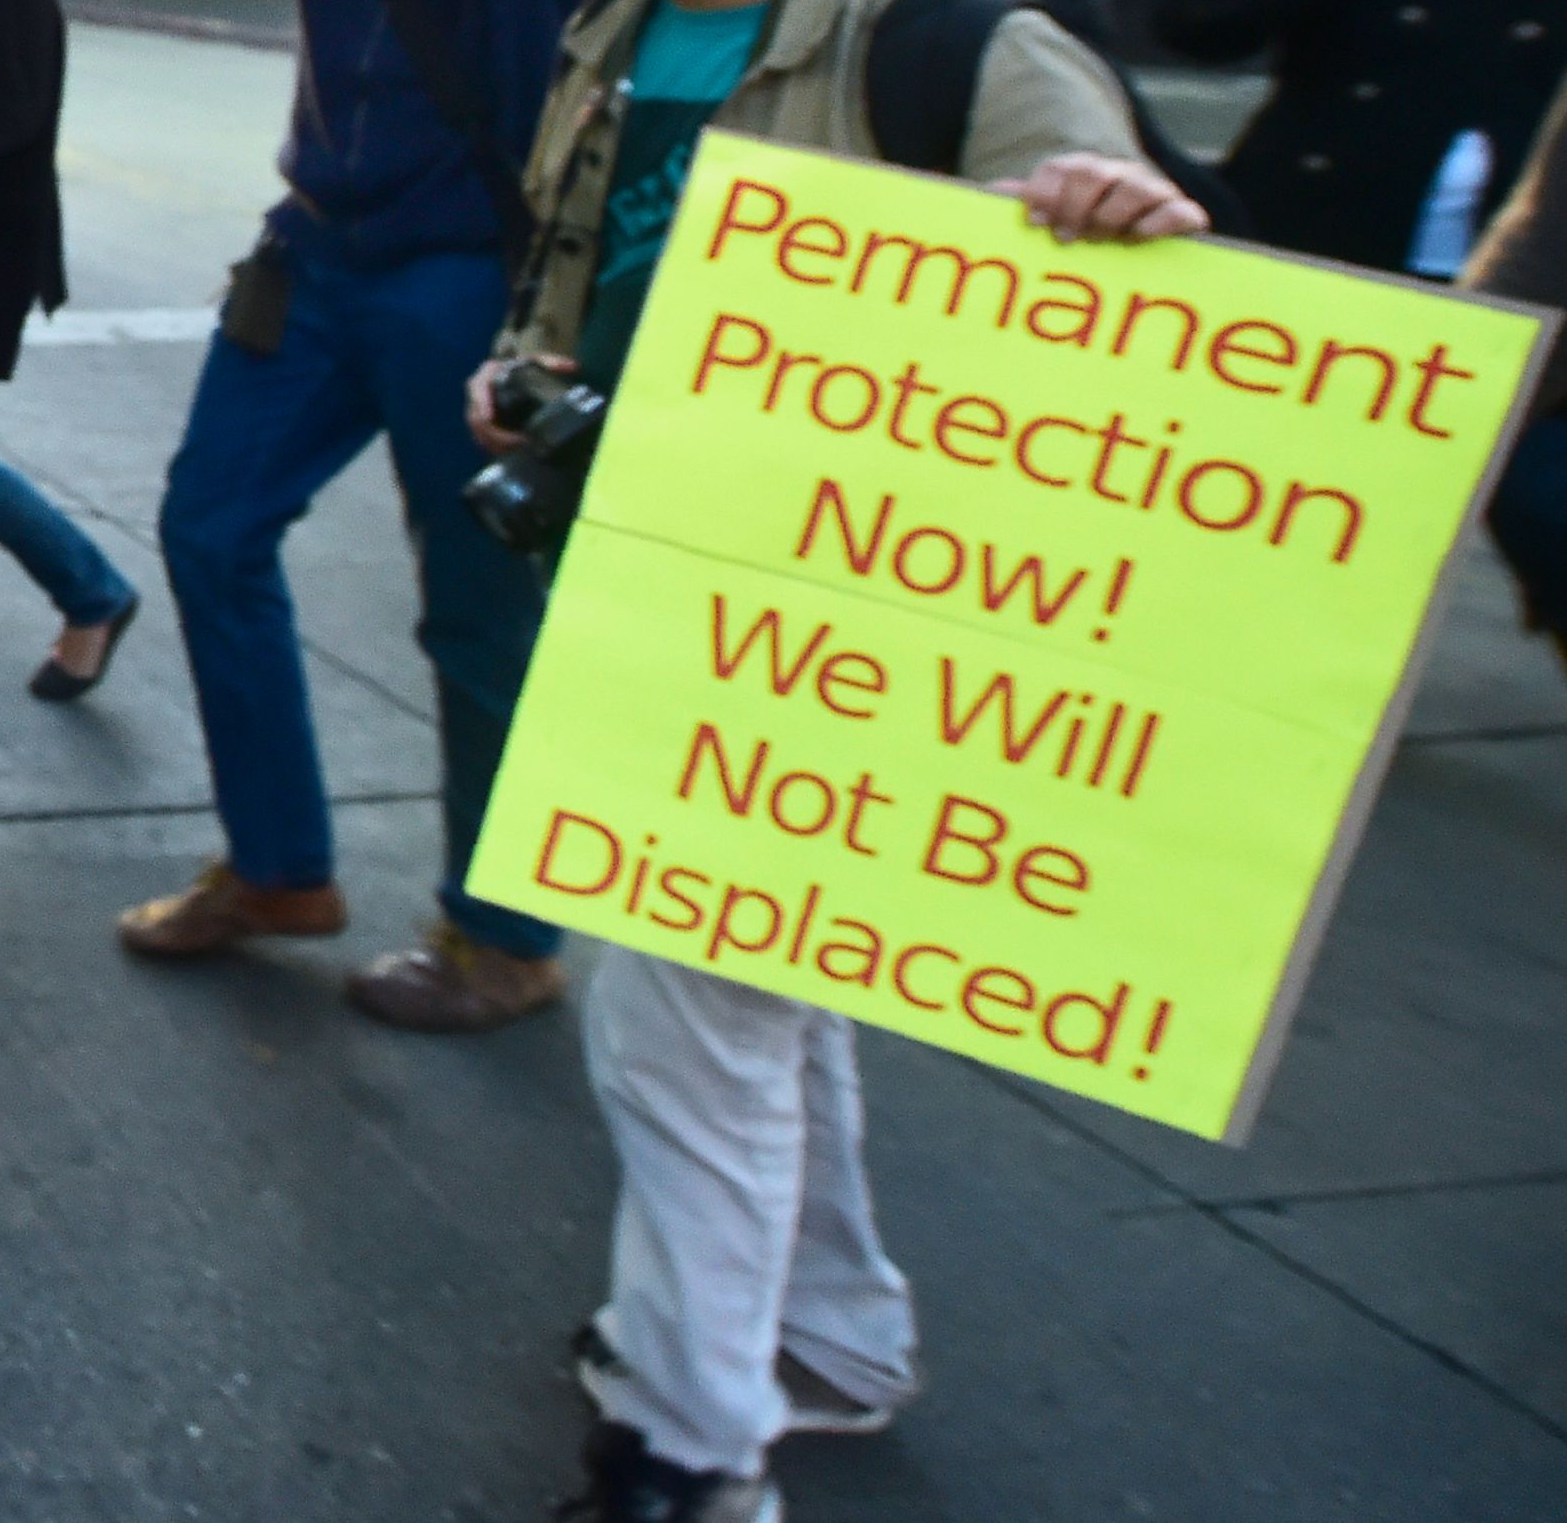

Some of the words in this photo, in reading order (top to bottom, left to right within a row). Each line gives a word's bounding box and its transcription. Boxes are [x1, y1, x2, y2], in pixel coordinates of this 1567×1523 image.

[705, 177, 1475, 440] Permanent
[691, 312, 1365, 564] Protection
[795, 477, 1135, 643] Now!
[710, 594, 889, 720] We
[940, 657, 1161, 798] Will
[678, 721, 893, 856] Not
[922, 794, 1092, 917] Be
[534, 809, 1175, 1081] Displaced!
